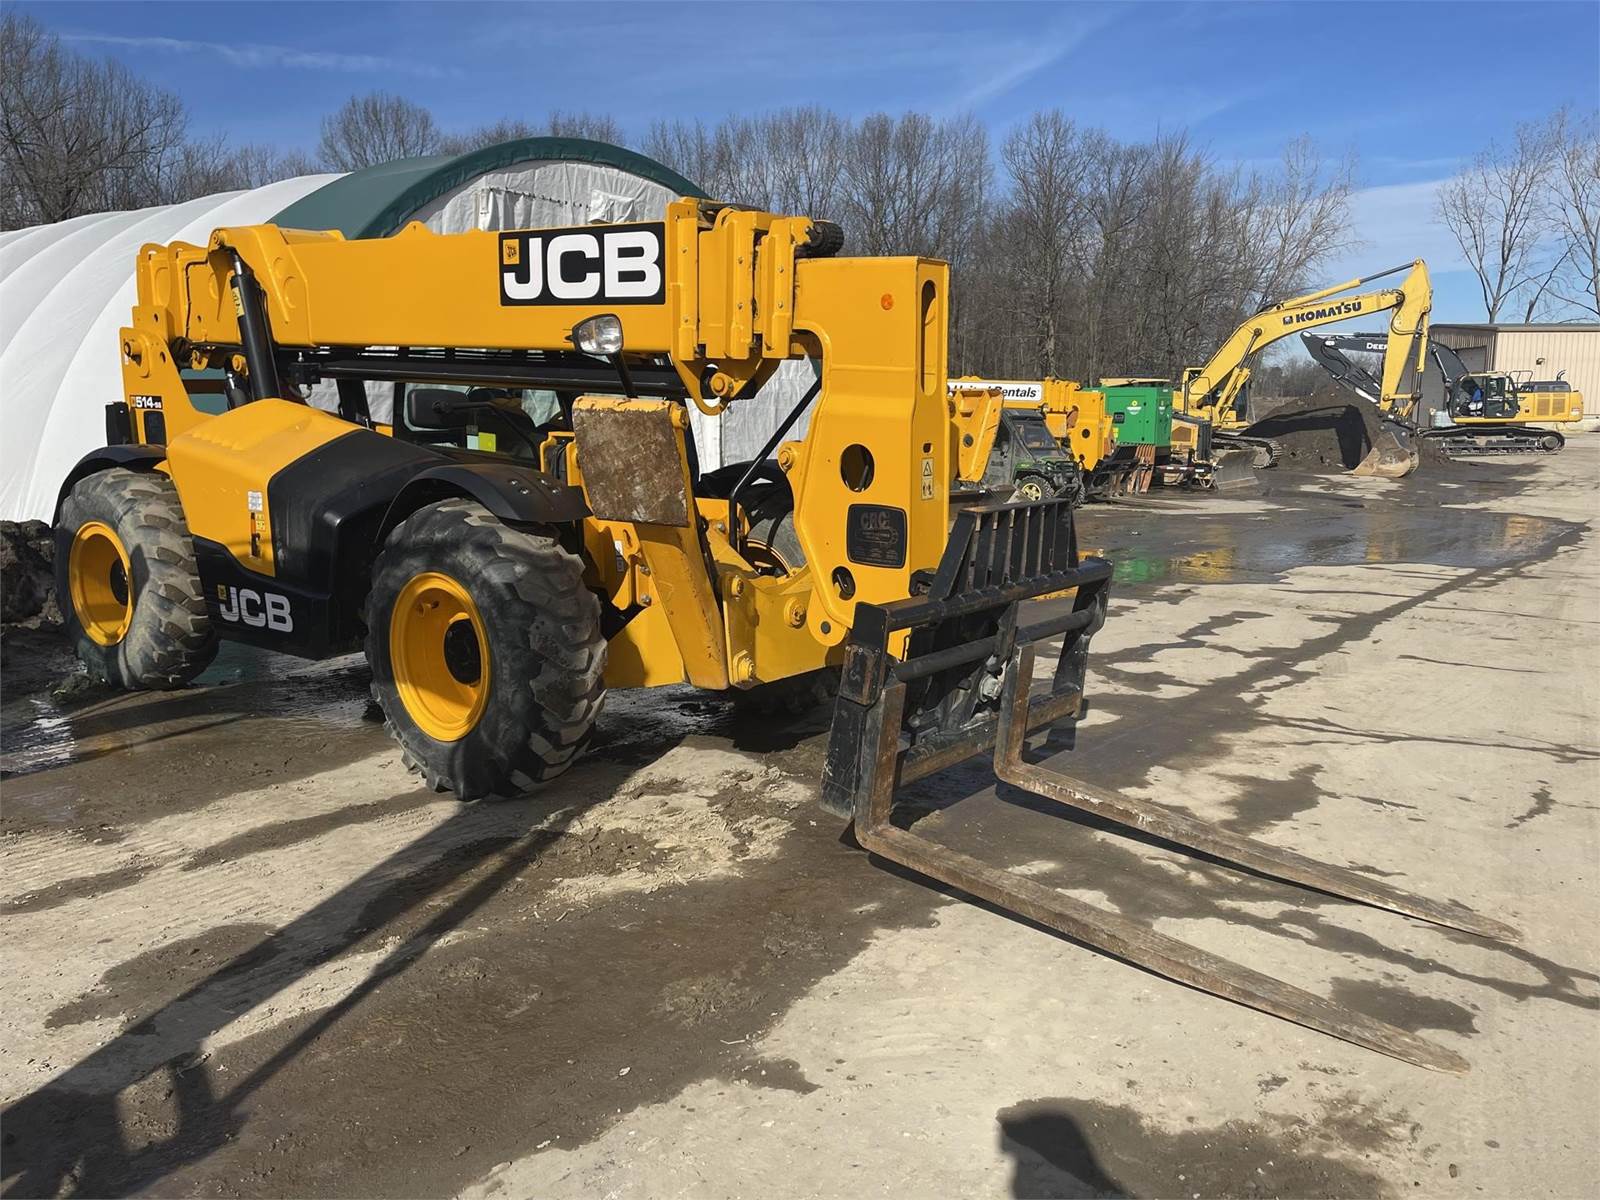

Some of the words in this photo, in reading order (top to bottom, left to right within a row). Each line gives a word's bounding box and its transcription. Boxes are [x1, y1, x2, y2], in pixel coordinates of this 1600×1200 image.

[503, 231, 661, 300] JCB
[1296, 301, 1362, 323] KOMATSU
[219, 586, 293, 633] JCB
